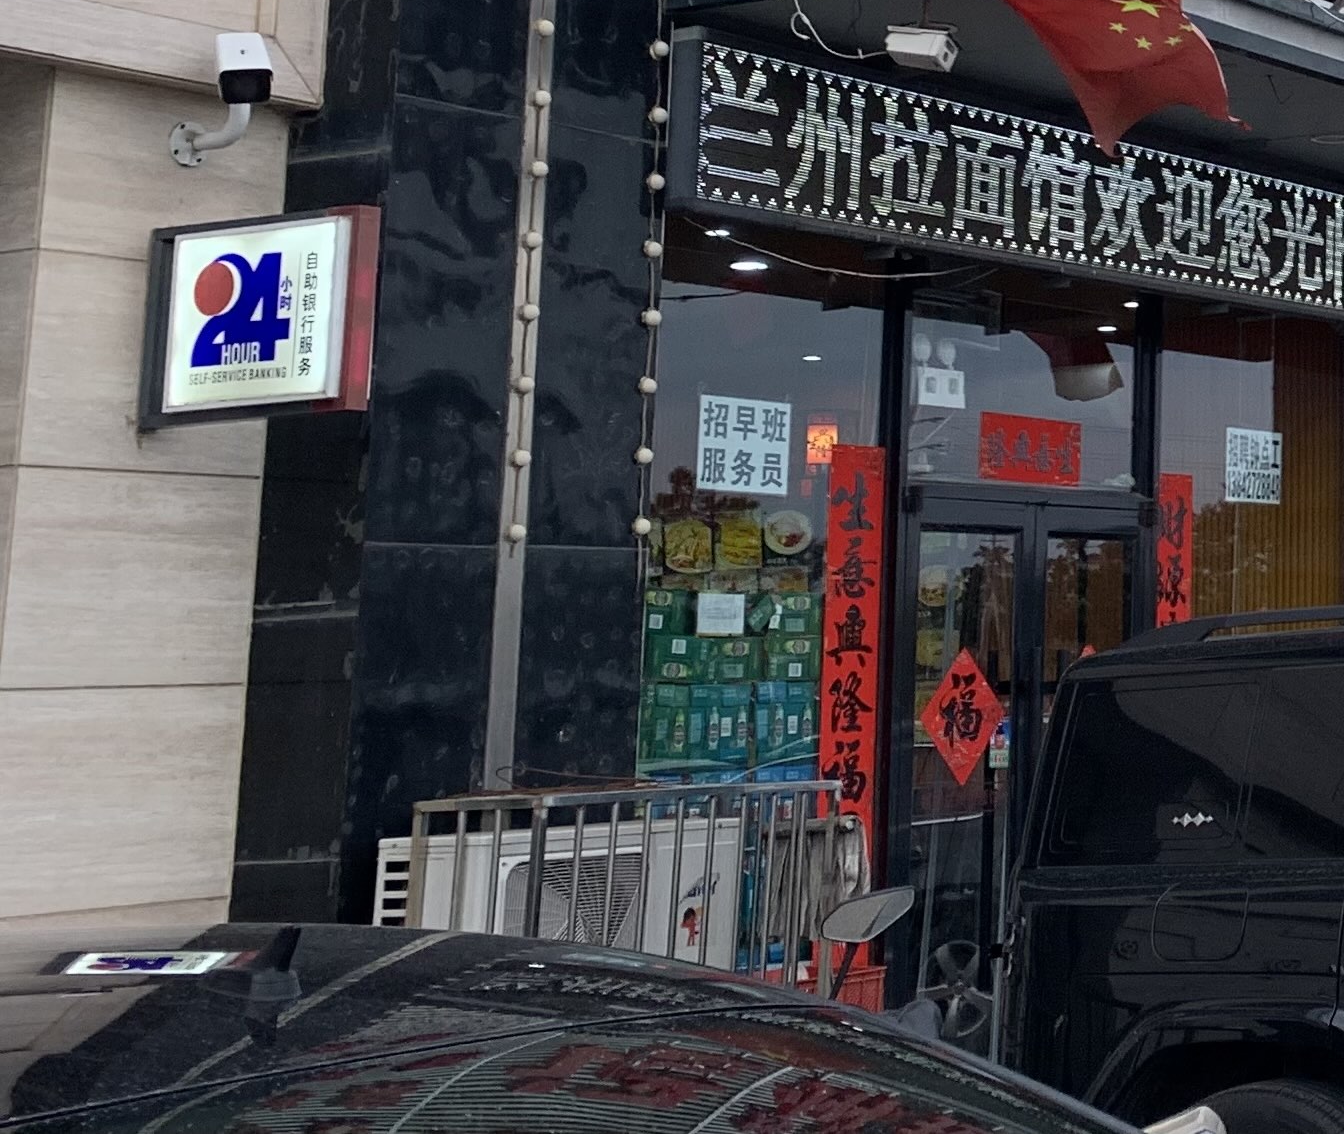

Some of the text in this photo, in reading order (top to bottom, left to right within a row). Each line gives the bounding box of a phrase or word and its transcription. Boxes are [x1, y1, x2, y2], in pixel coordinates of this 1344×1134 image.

[190, 251, 291, 368] 24
[279, 275, 293, 312] 小时
[297, 251, 319, 377] 自助银行服务
[221, 341, 261, 365] HOUR
[188, 366, 288, 386] SELF-SERVICE BANKING
[703, 400, 788, 443] 招早班
[700, 447, 783, 488] 服务员
[939, 672, 983, 749] 福
